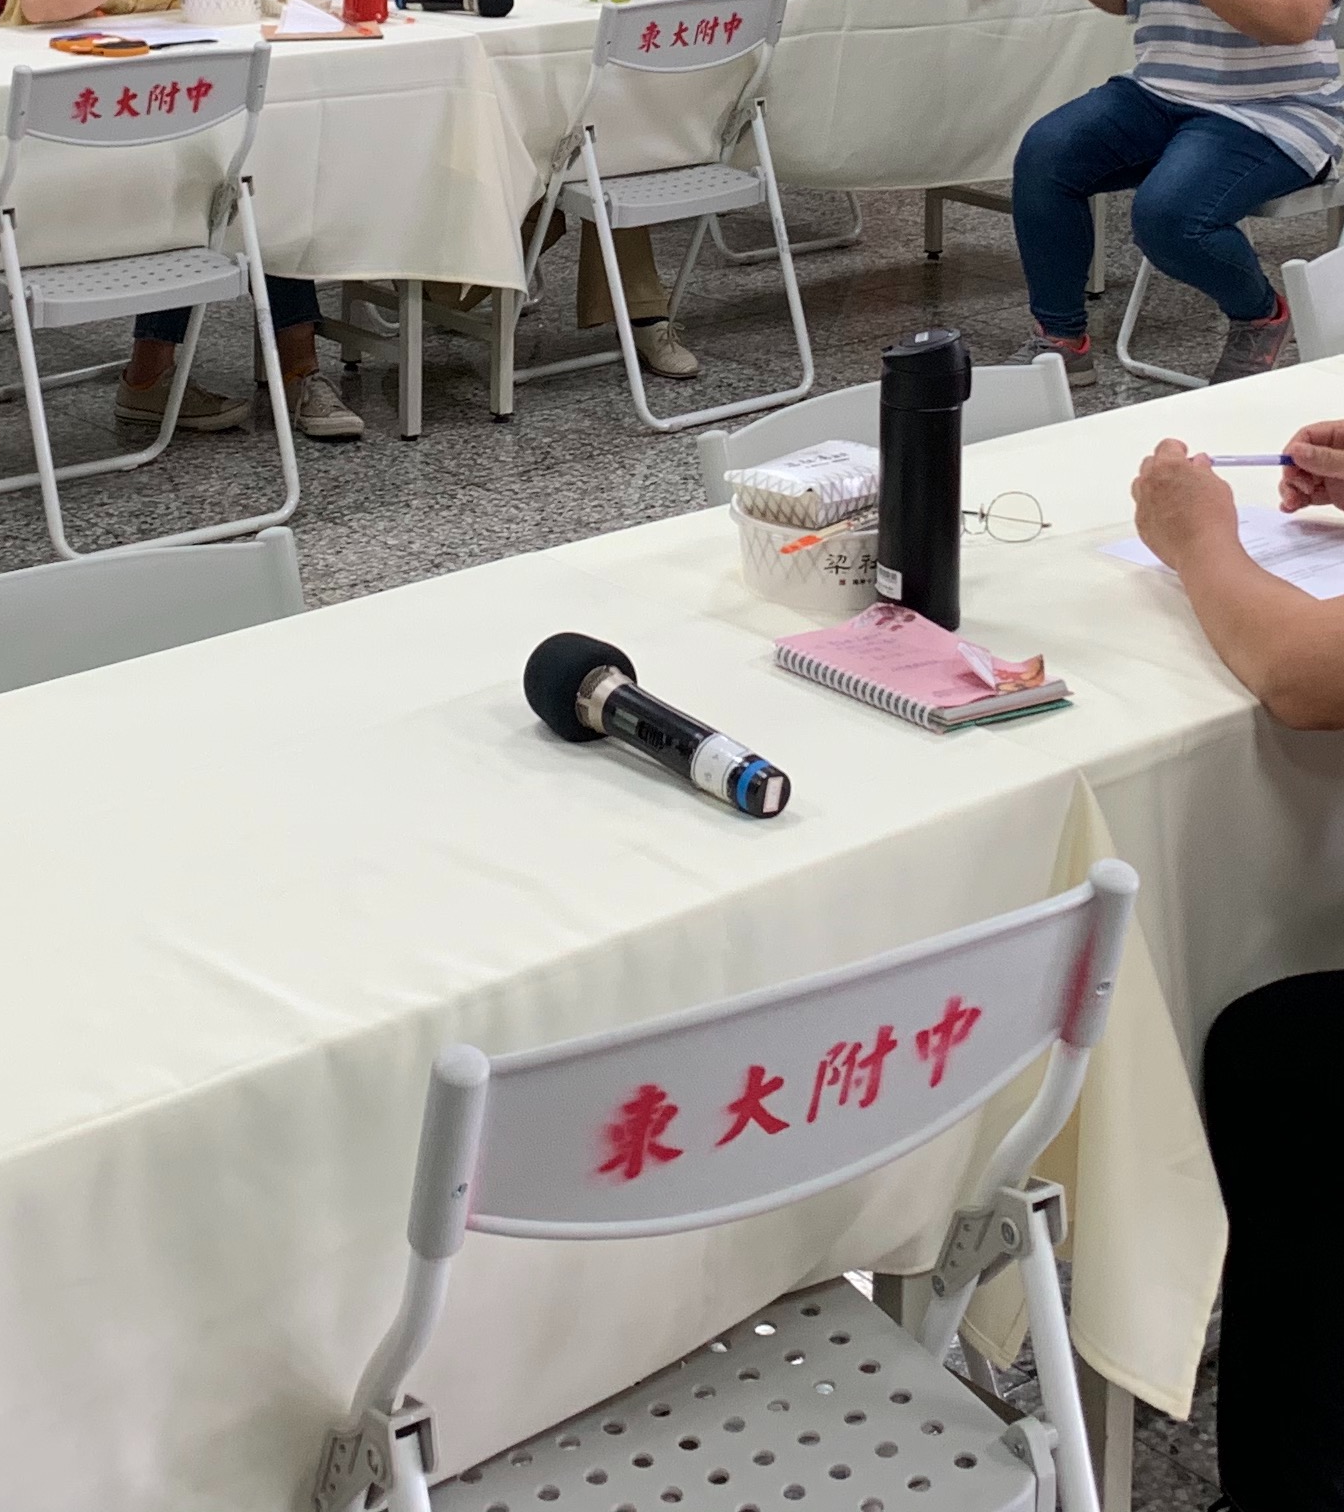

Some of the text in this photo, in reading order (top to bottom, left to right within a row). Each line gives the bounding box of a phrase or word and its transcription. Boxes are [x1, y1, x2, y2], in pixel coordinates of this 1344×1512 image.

[638, 11, 743, 53] 東大附中
[71, 76, 213, 124] 東大附中
[595, 994, 983, 1180] 東大附中
